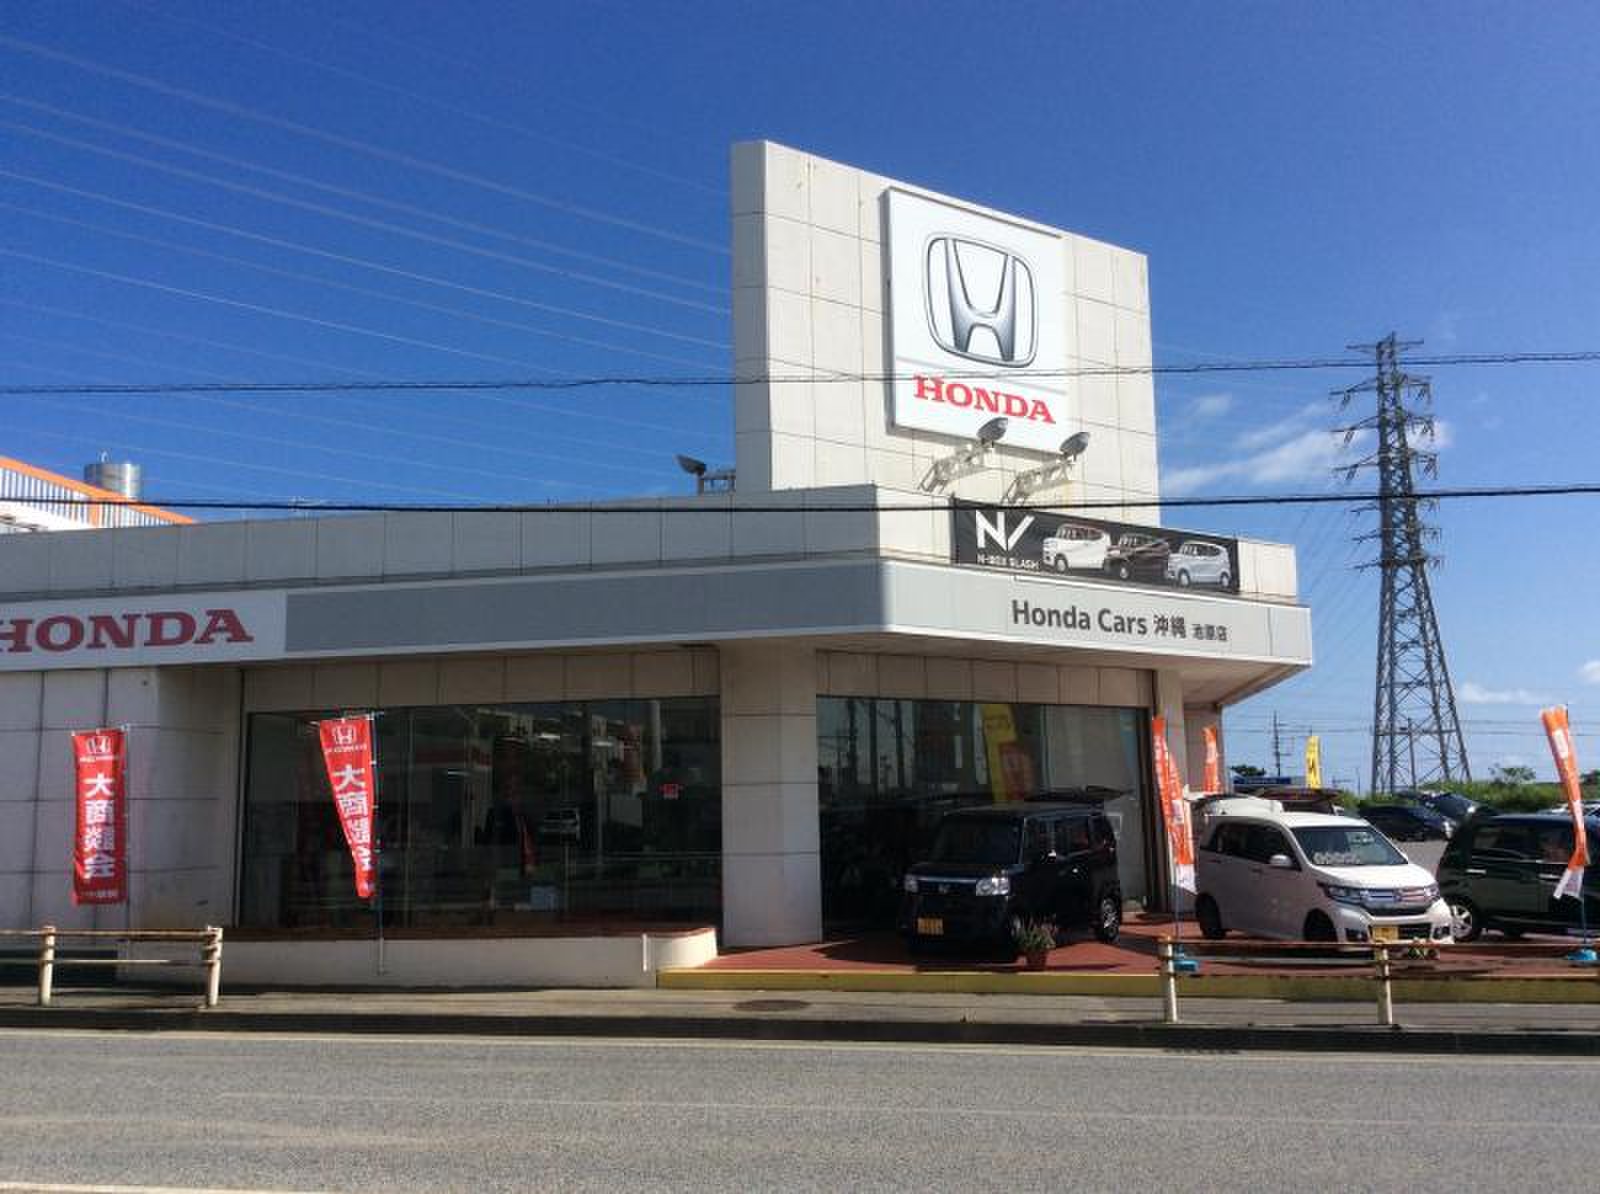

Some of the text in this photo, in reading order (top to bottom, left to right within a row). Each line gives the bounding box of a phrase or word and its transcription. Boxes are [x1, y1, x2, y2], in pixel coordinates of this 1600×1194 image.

[913, 373, 1056, 424] HONDA
[1012, 599, 1091, 630] Honda
[1097, 608, 1148, 635] Cars
[1153, 613, 1187, 638] 沖縄
